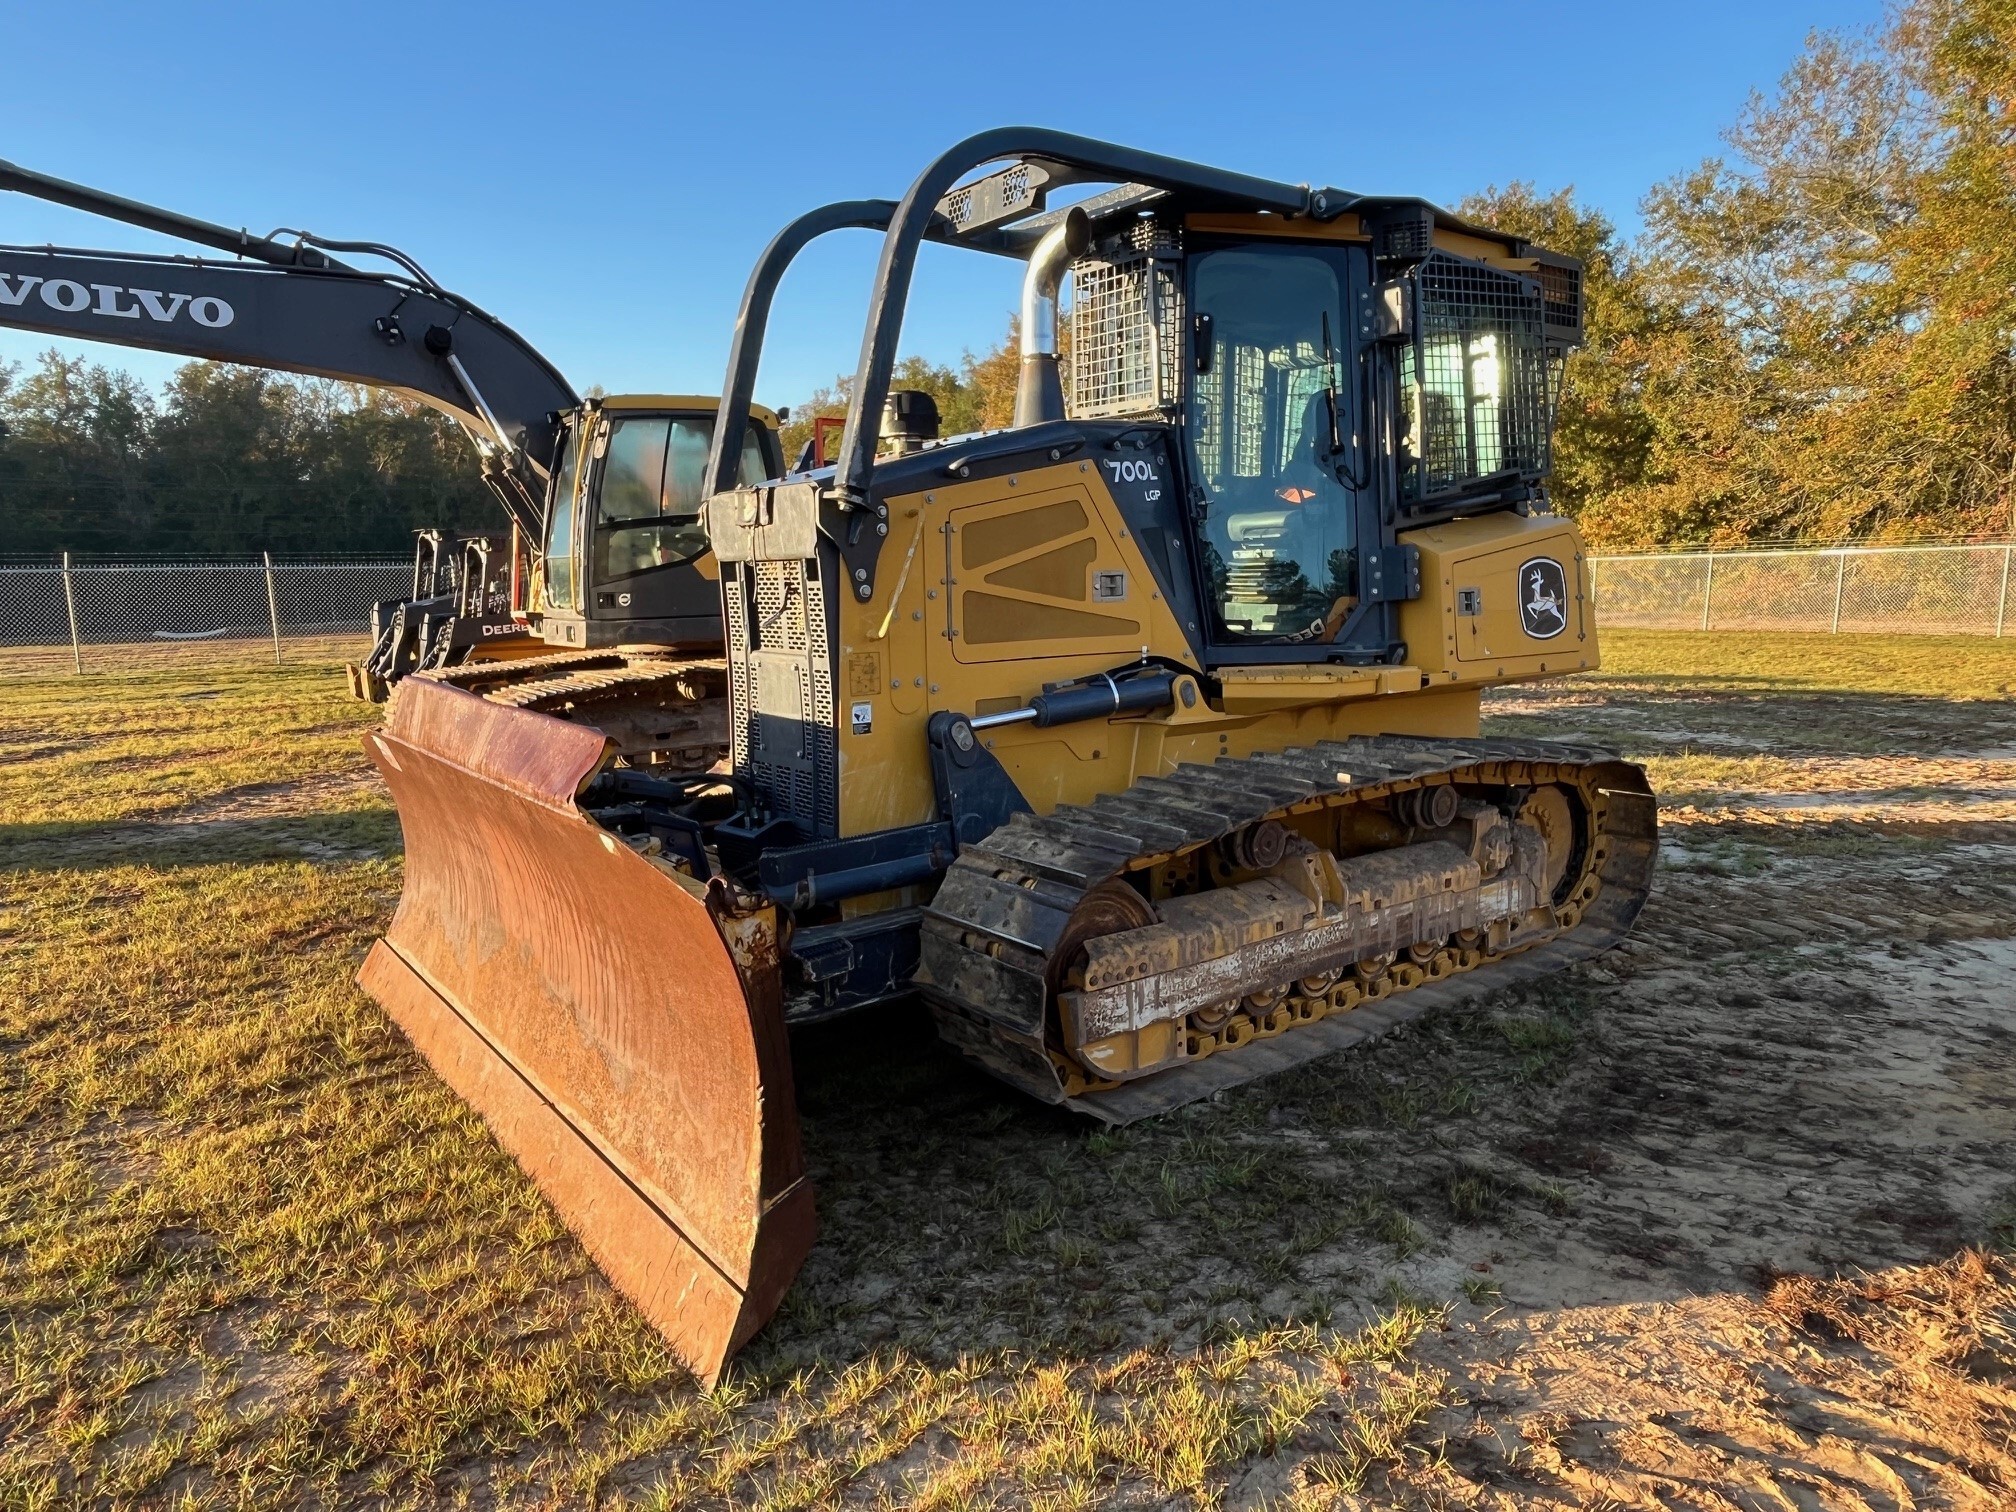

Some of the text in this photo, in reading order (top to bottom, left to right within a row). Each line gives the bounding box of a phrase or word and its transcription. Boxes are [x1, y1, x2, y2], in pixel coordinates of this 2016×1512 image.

[0, 273, 235, 328] VOLVO
[1109, 460, 1158, 483] 700L
[1144, 489, 1161, 502] LGP
